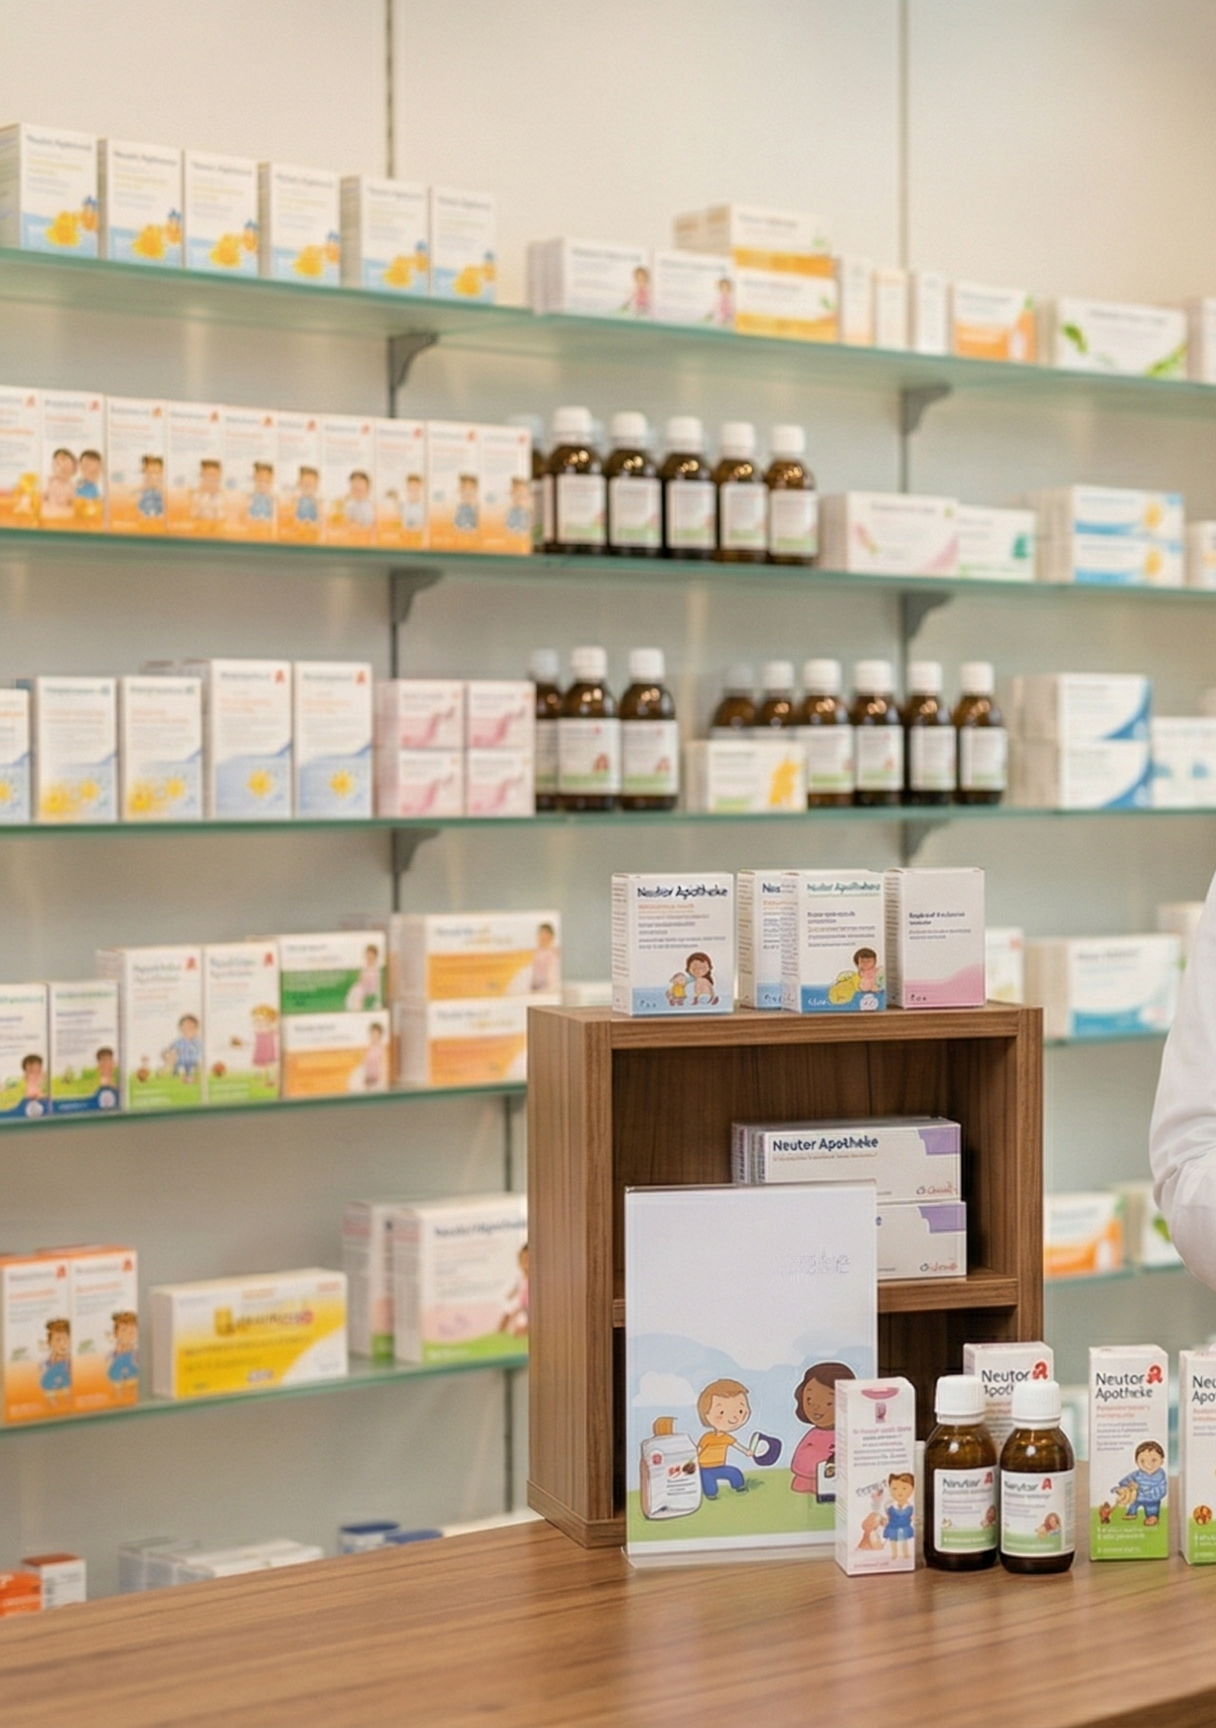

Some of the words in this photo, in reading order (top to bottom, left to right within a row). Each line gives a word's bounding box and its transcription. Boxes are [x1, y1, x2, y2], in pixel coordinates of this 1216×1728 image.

[819, 1135, 878, 1152] Apotheke
[981, 1370, 1030, 1382] Neutor
[1095, 1373, 1145, 1386] Neutor
[1095, 1386, 1153, 1402] Apotheke
